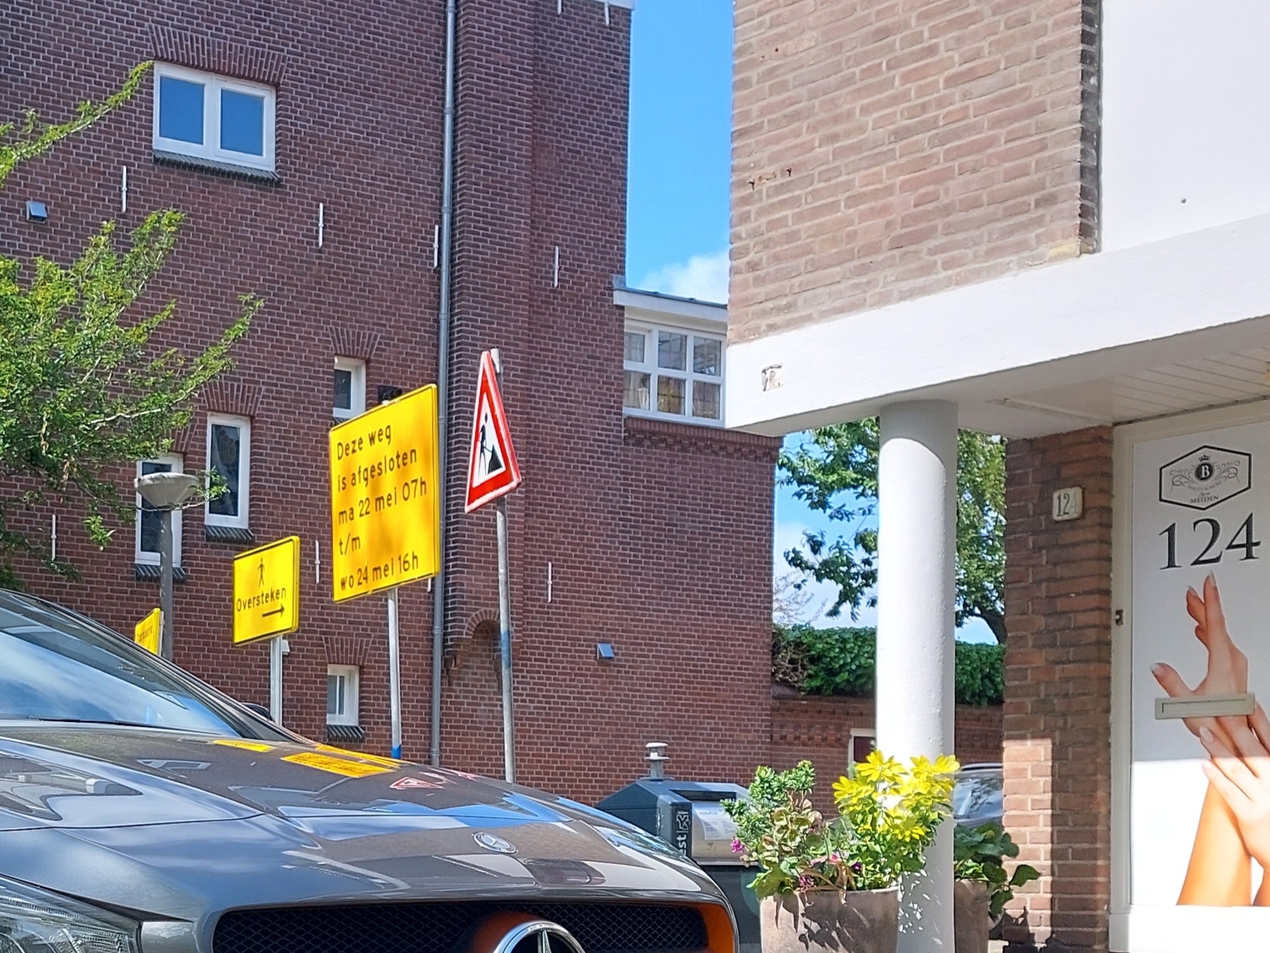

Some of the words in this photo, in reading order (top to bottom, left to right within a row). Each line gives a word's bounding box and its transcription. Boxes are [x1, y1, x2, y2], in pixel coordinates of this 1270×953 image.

[337, 437, 363, 460] Deze
[368, 425, 391, 445] weg
[338, 475, 347, 493] is
[351, 448, 417, 488] afgesloten
[1201, 465, 1210, 478] B
[338, 507, 355, 525] ma
[358, 497, 371, 518] 22
[374, 486, 397, 512] mei
[402, 476, 427, 501] 07h
[338, 533, 361, 555] t/m
[1159, 512, 1261, 570] 124
[340, 575, 354, 591] wo
[357, 566, 369, 586] 24
[372, 557, 394, 581] mei
[398, 551, 419, 574] 16h
[236, 587, 286, 612] Oversteken
